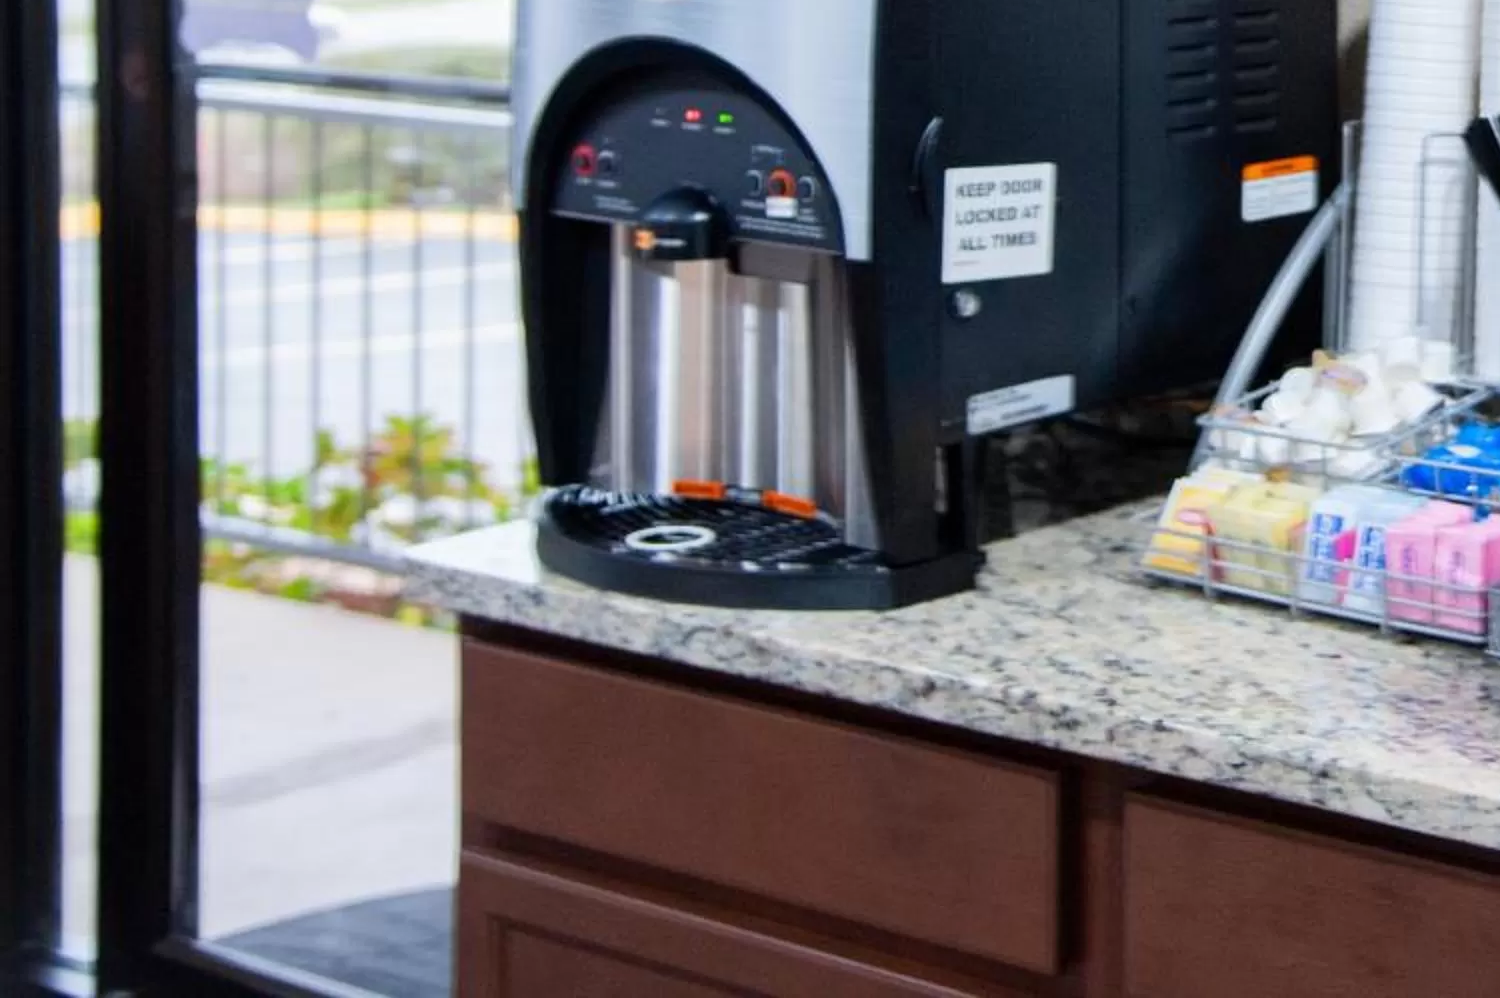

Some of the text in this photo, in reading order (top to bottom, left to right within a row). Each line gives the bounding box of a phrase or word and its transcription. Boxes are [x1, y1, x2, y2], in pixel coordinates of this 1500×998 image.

[956, 178, 1042, 198] KEEP DOOR
[956, 203, 1042, 226] LOCKED AT
[959, 231, 1037, 251] ALL TIMES
